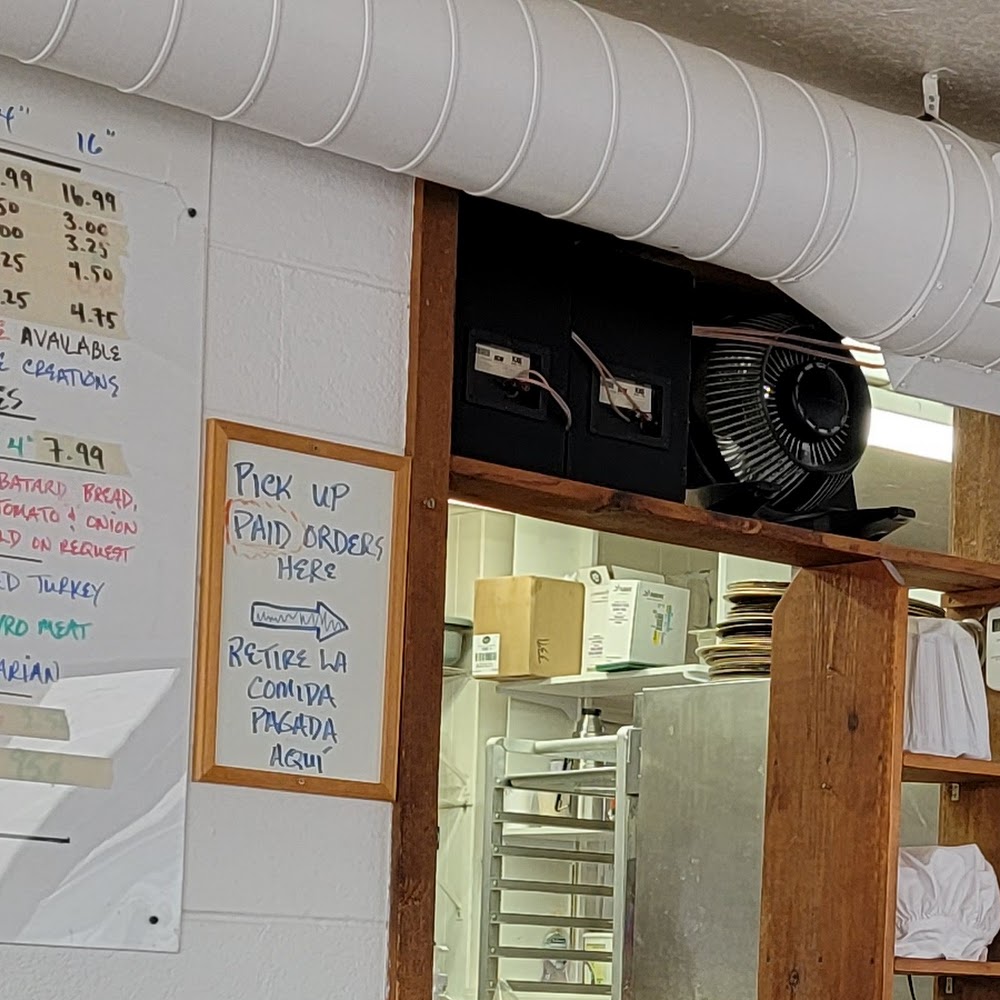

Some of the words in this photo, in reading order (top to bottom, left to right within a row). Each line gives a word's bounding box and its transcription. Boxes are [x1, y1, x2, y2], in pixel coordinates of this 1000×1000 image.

[77, 129, 115, 154] 16"
[61, 183, 117, 212] 16.99
[63, 212, 108, 236] 3.00
[64, 234, 109, 259] 3.25
[68, 261, 113, 283] 4.50
[71, 303, 118, 330] 4.75
[21, 326, 122, 361] AVAILABLE
[22, 359, 119, 398] CREATIONS
[43, 437, 105, 470] 7.99
[233, 462, 292, 500] PICK
[312, 483, 350, 511] UP
[86, 511, 137, 535] ONION
[233, 510, 292, 549] PAID
[303, 525, 384, 561] ORDERS
[32, 536, 52, 551] ON
[59, 539, 135, 563] REQUEST
[278, 557, 337, 582] HERE
[27, 575, 104, 607] TURKEY
[38, 618, 92, 640] MEAT
[229, 637, 310, 671] RETIRE
[320, 649, 347, 673] LA
[248, 676, 337, 708] COMIDA
[252, 707, 337, 744] PAGADA
